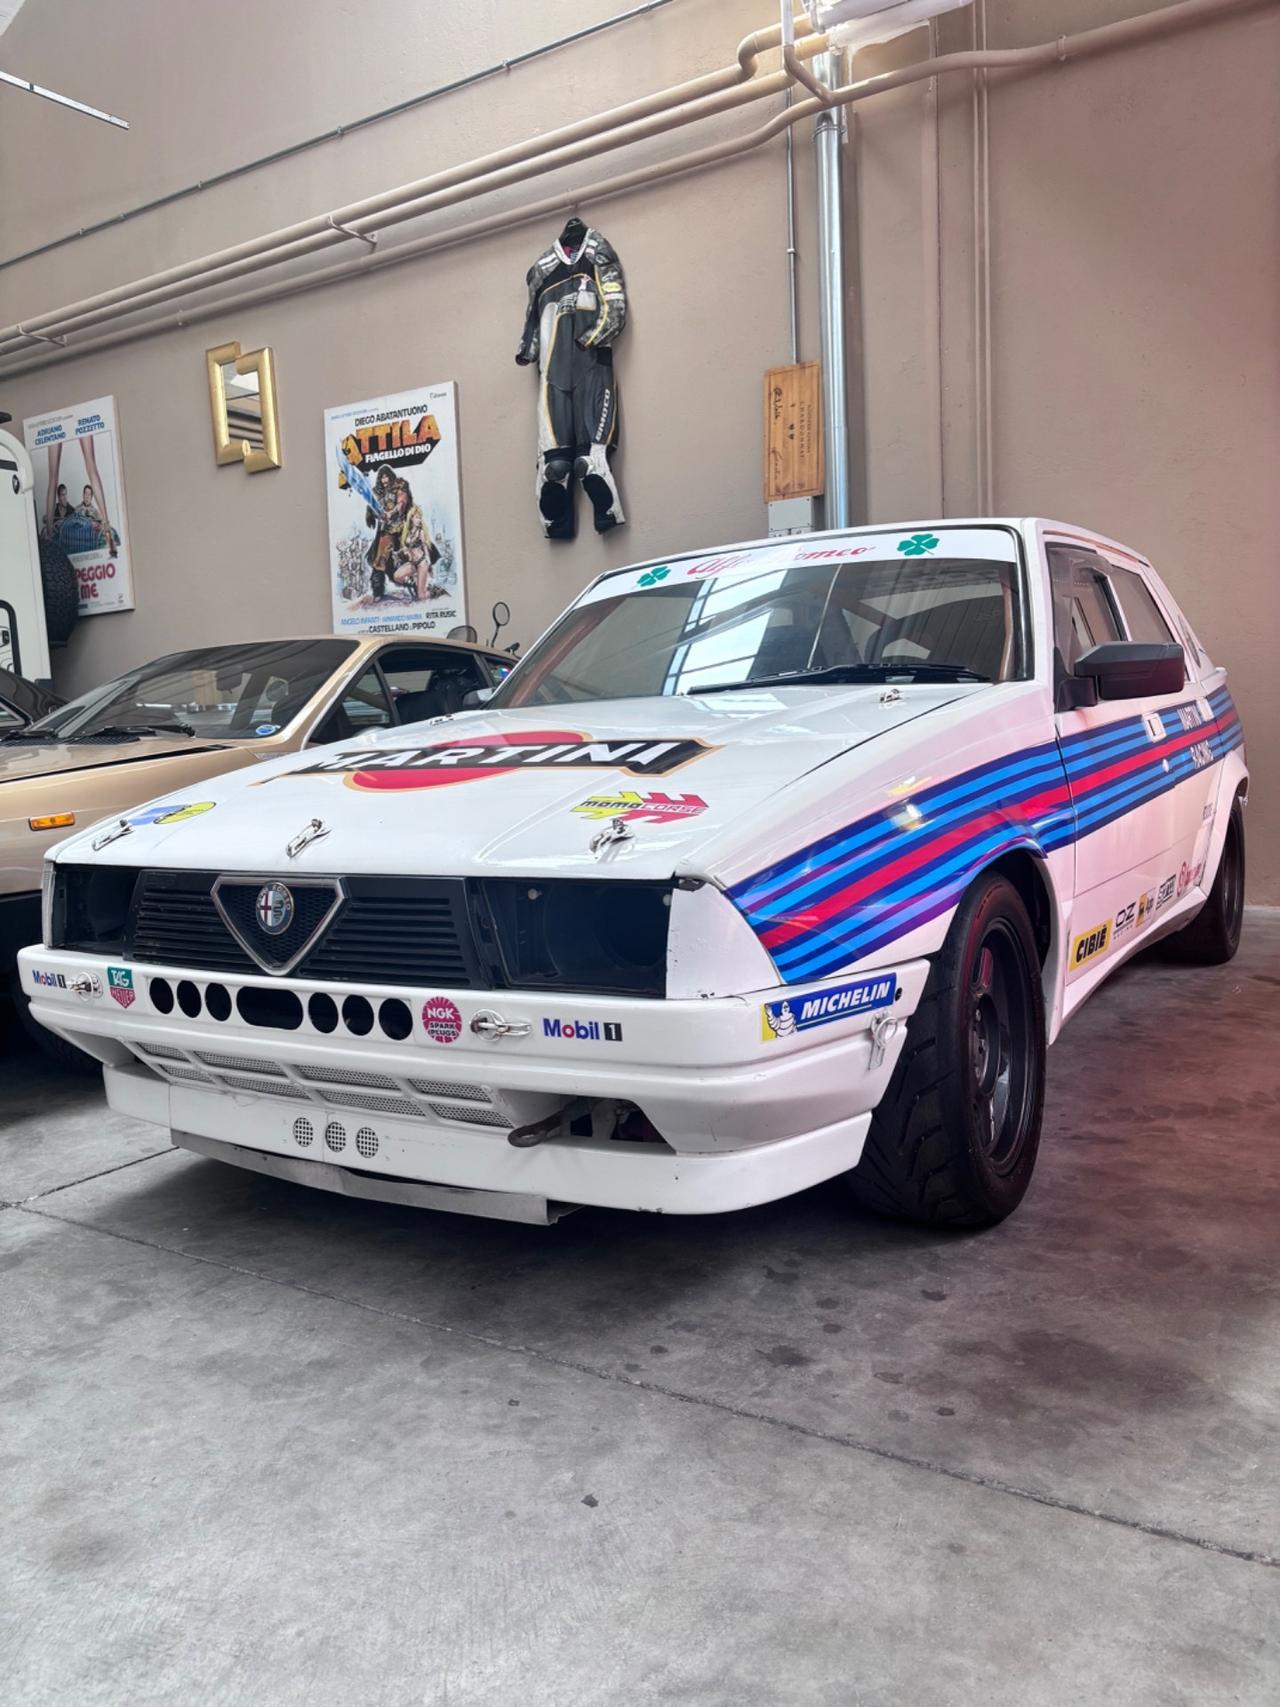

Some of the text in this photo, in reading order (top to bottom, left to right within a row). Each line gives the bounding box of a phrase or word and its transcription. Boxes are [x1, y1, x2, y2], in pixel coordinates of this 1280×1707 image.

[78, 414, 101, 425] RENATO
[354, 414, 375, 426] DIEGO
[375, 404, 428, 422] ABATANTUONO
[37, 424, 63, 437] ADRIANO
[75, 422, 105, 435] POZZETTO
[34, 432, 66, 445] CELENTANO
[341, 415, 442, 466] ATTILA
[364, 443, 432, 463] FLAGELLO DI DIO
[74, 563, 116, 582] PEGGIO
[80, 583, 99, 600] ME
[368, 623, 409, 633] CASTELLANO
[412, 621, 436, 631] PIPOLO
[310, 742, 683, 770] MARTINI
[1115, 901, 1136, 928] OZ
[32, 969, 57, 987] Mobil
[111, 969, 130, 987] TAG
[801, 981, 891, 1020] MICHELIN
[427, 1007, 455, 1020] NGK
[429, 1021, 456, 1030] SPARK
[429, 1029, 457, 1037] PLUGS
[543, 1018, 600, 1040] Mobil
